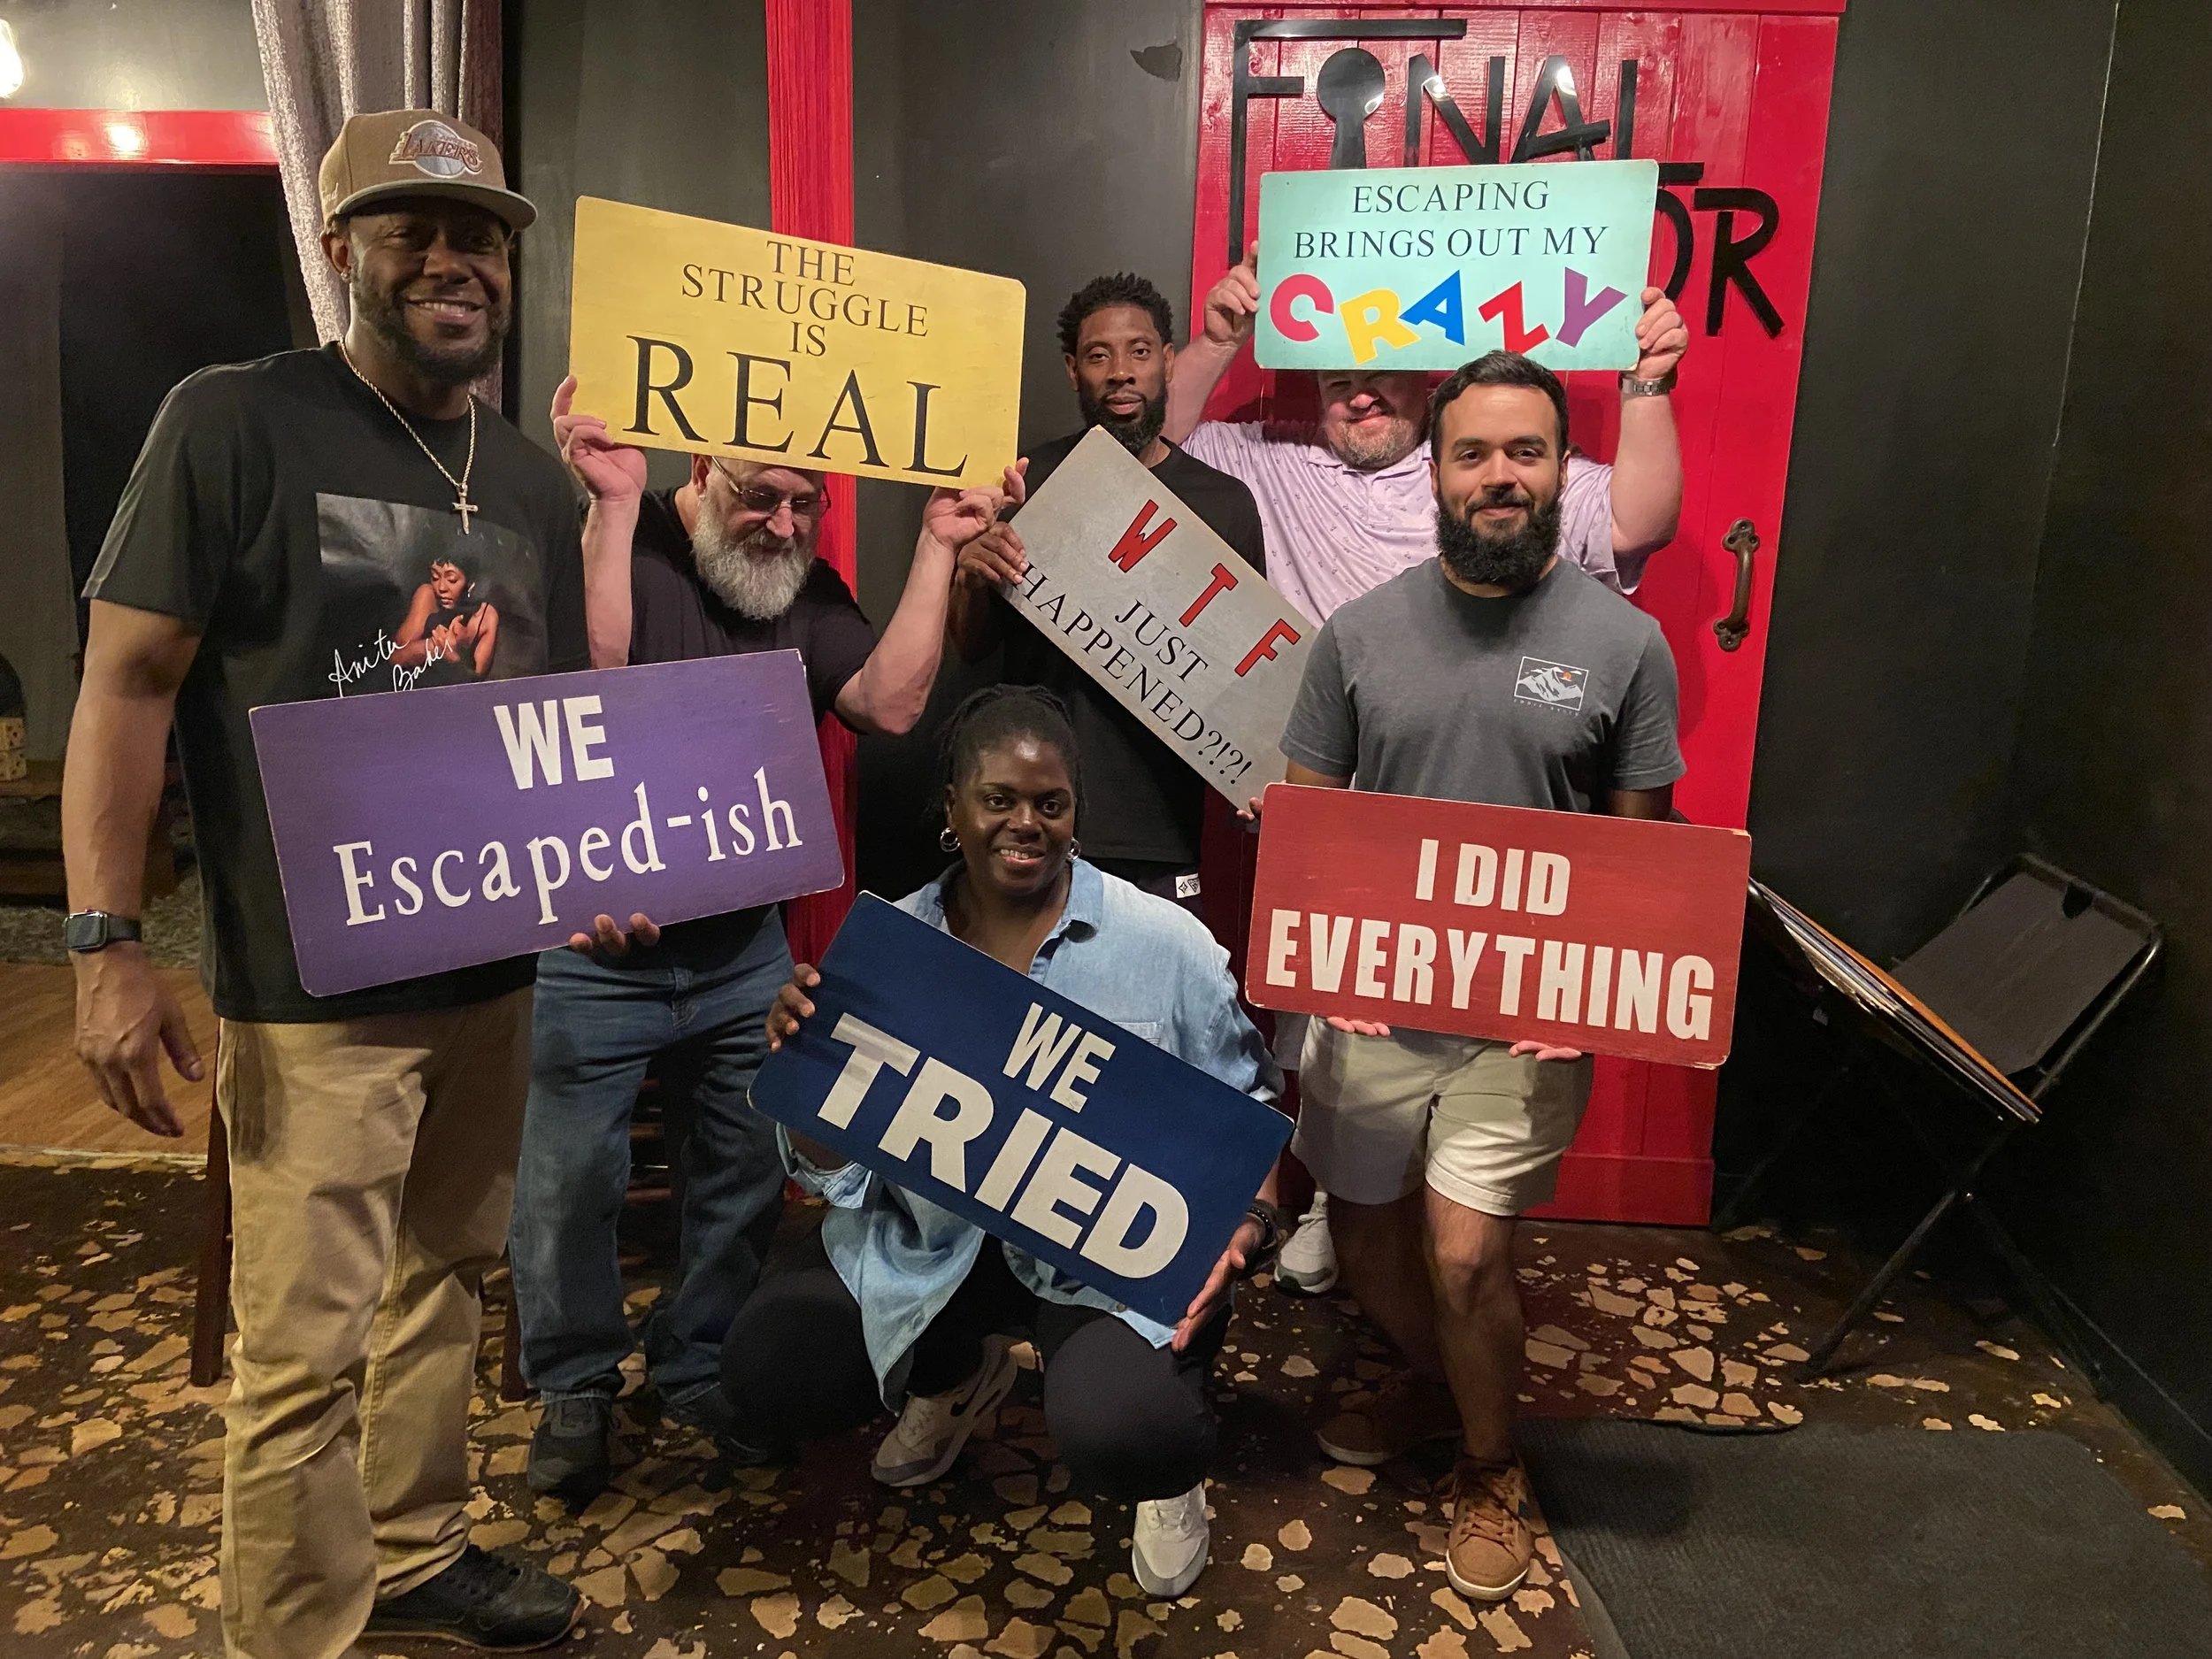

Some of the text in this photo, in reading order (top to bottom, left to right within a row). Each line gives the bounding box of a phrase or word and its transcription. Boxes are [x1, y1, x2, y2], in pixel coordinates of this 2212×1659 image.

[392, 133, 482, 173] LAKERS
[1352, 180, 1550, 214] ESCAPING
[767, 240, 856, 287] THE
[1294, 226, 1609, 259] BRINGS OUT MY
[681, 264, 929, 338] STRUGGLE
[789, 321, 826, 357] IS
[1270, 266, 1628, 365] CRAZY
[622, 334, 969, 478] REAL
[328, 628, 410, 698] Anita
[1011, 560, 1252, 785] HAPPENED?!?!
[1114, 598, 1209, 683] JUST
[493, 695, 615, 791] WE
[333, 765, 803, 926] Escaped-ish
[1416, 839, 1571, 917] I DID
[1265, 908, 1715, 1041] EVERYTHING
[1002, 1002, 1117, 1114] WE
[817, 1012, 1189, 1279] TRIED
